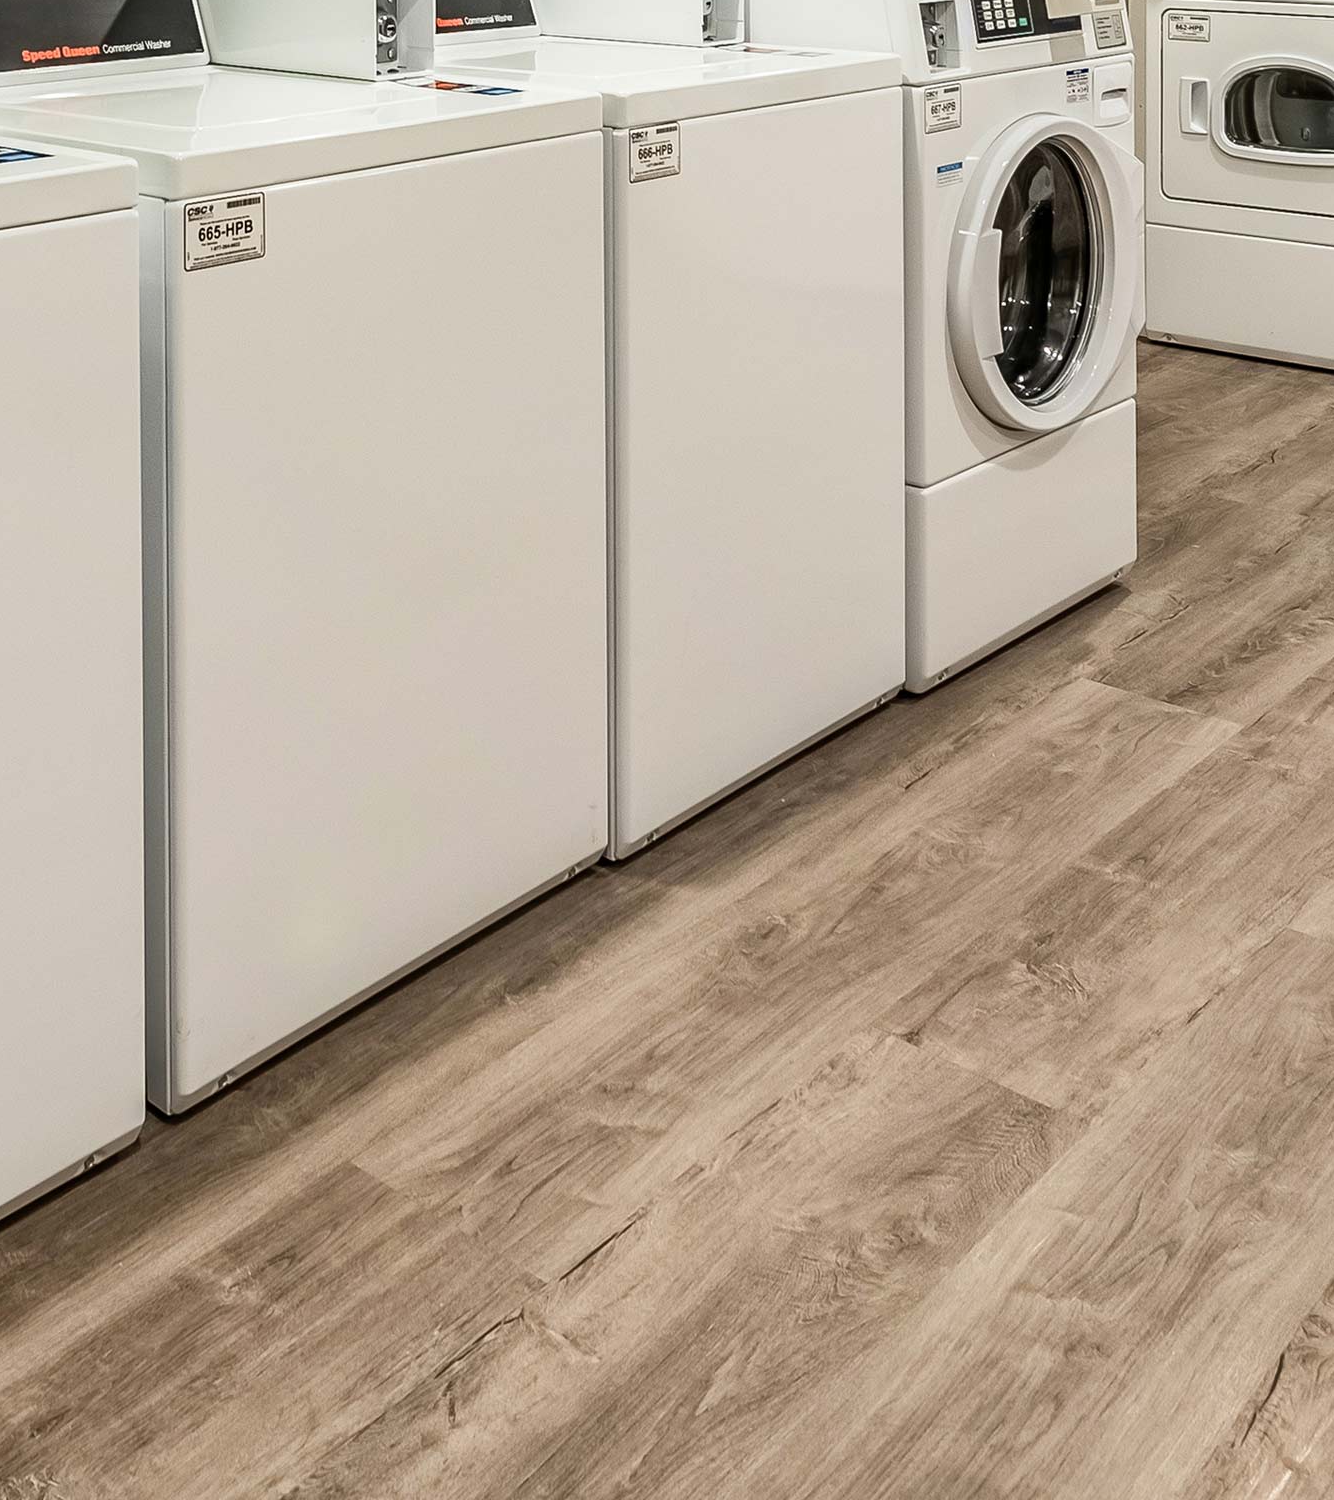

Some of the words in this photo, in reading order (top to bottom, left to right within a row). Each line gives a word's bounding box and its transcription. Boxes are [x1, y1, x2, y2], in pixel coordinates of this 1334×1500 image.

[22, 47, 61, 63] Speed
[62, 45, 101, 57] Queen
[102, 41, 145, 54] Commercial
[146, 39, 171, 50] Washer
[638, 143, 673, 160] 666-HPB
[187, 206, 208, 217] CSC
[198, 219, 253, 242] 665-HPB
